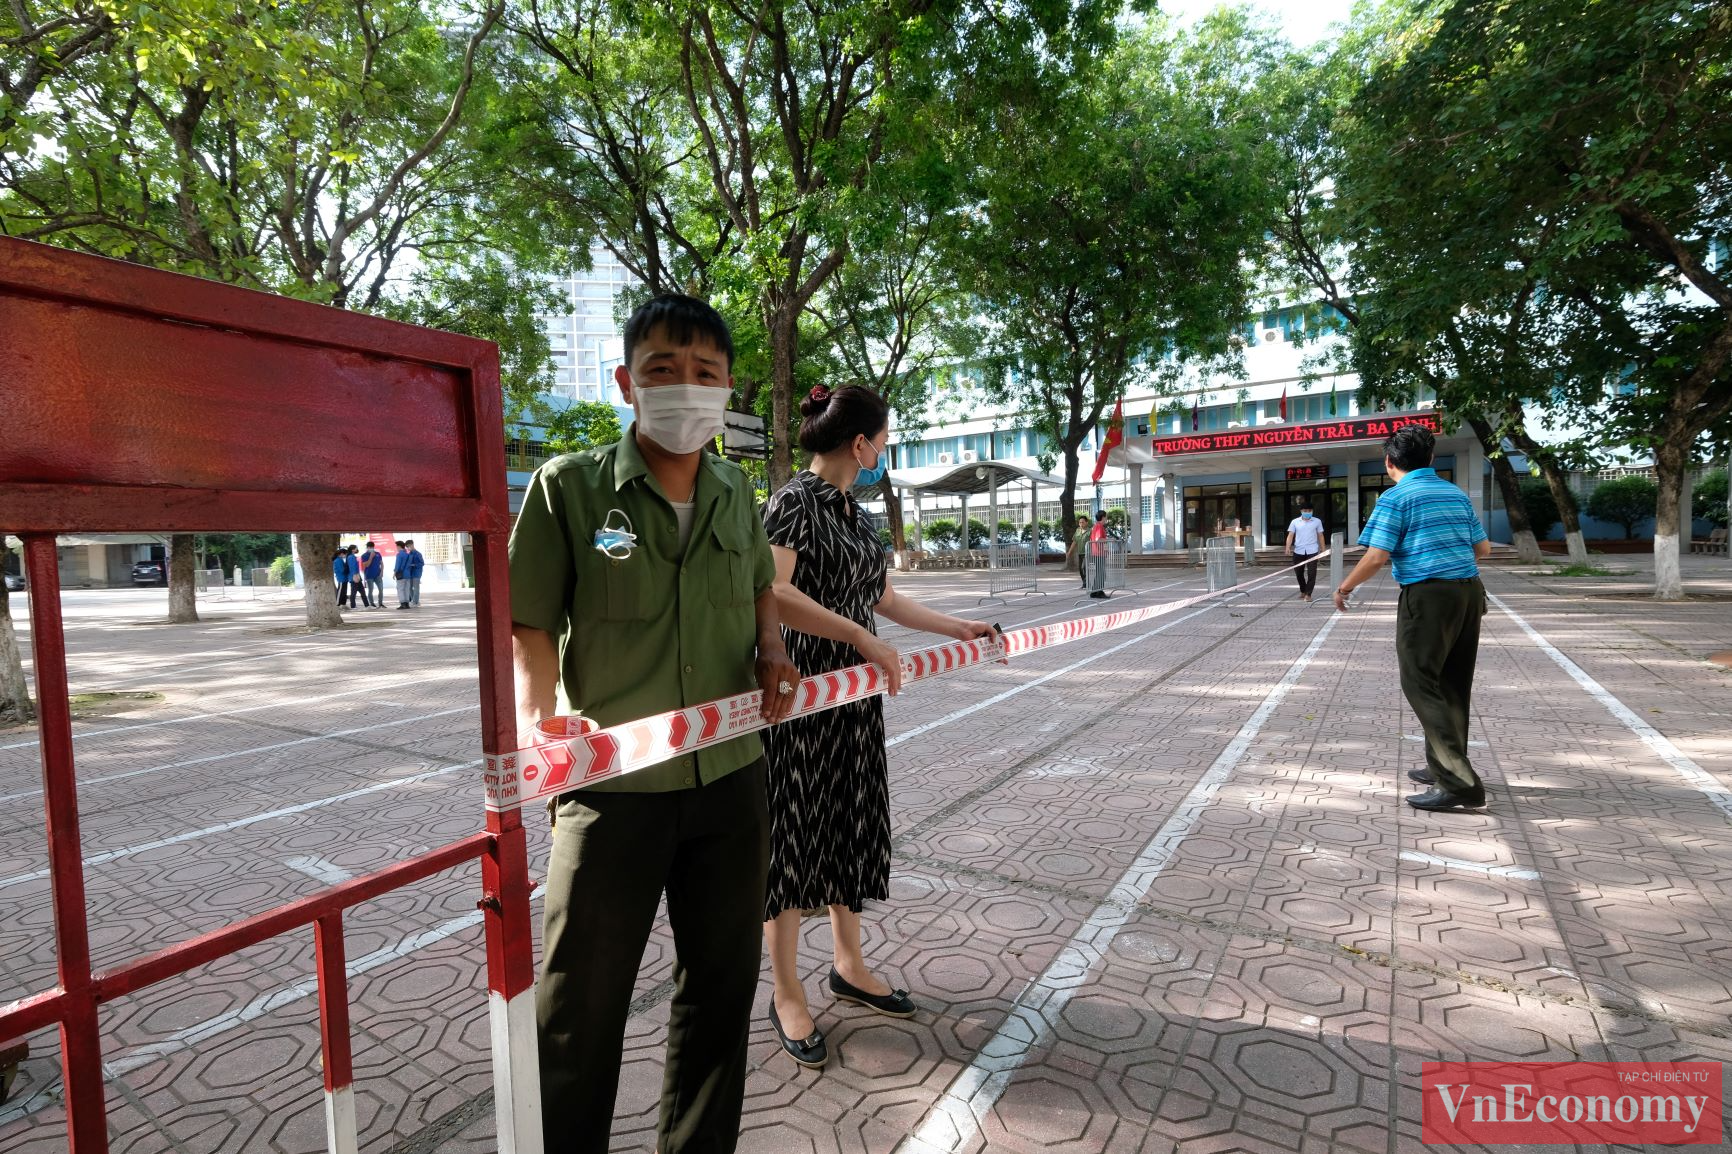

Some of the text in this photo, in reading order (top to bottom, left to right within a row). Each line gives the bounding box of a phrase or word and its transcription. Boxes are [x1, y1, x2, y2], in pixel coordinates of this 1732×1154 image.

[1155, 437, 1211, 453] TRƯỜNG
[1213, 434, 1251, 449] THPT
[1253, 425, 1314, 445] NGUYỄN
[1316, 423, 1354, 439] TRÃI
[1367, 422, 1389, 436] BA
[501, 772, 517, 785] NOT
[501, 786, 517, 799] KHU
